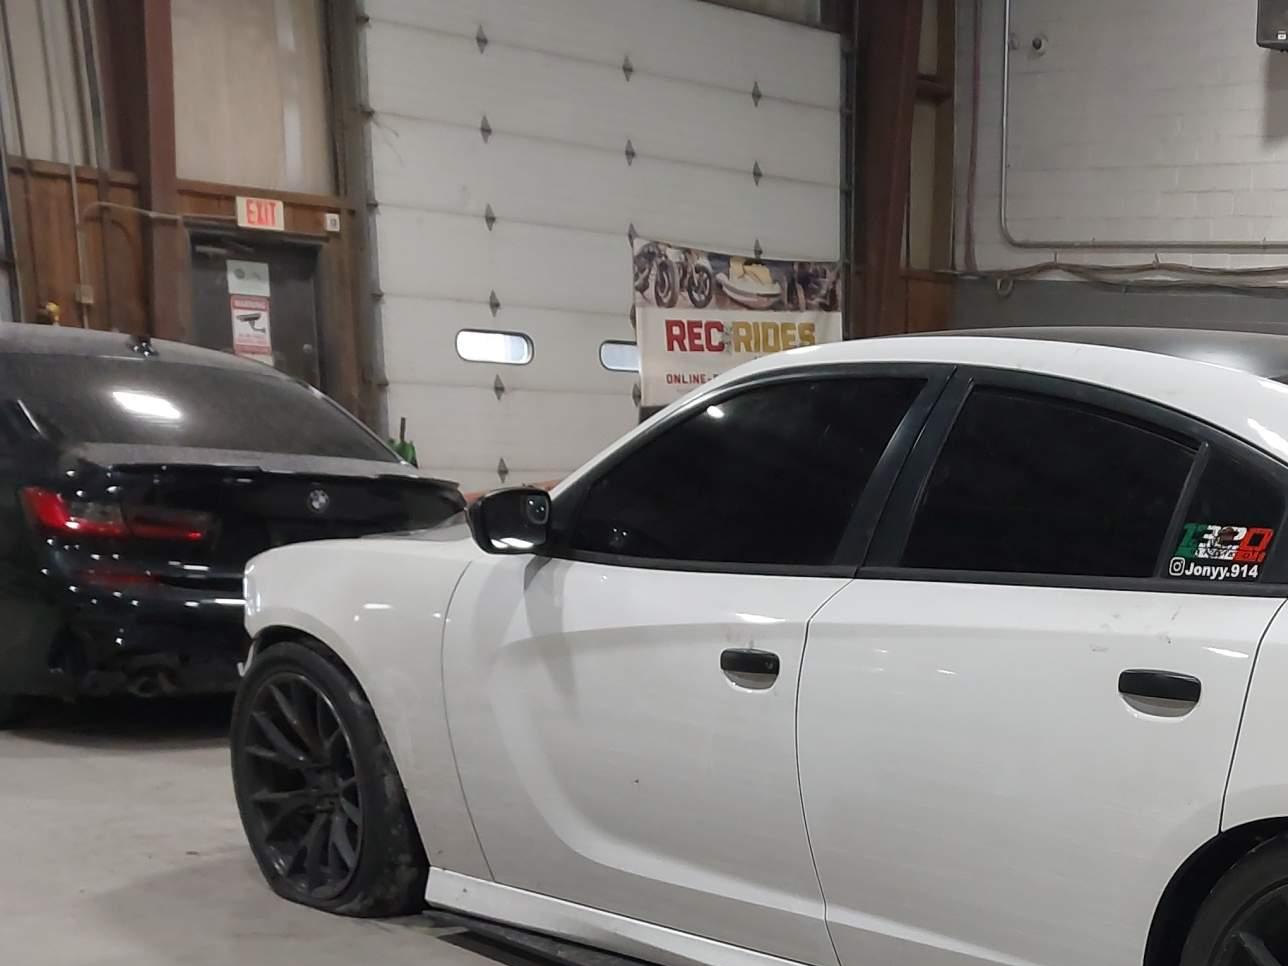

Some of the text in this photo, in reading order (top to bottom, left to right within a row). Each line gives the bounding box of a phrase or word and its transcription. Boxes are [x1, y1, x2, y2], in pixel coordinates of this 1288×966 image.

[245, 198, 277, 227] EXIT
[665, 320, 816, 352] REC RIDES
[1184, 561, 1259, 580] Jonyy.914
